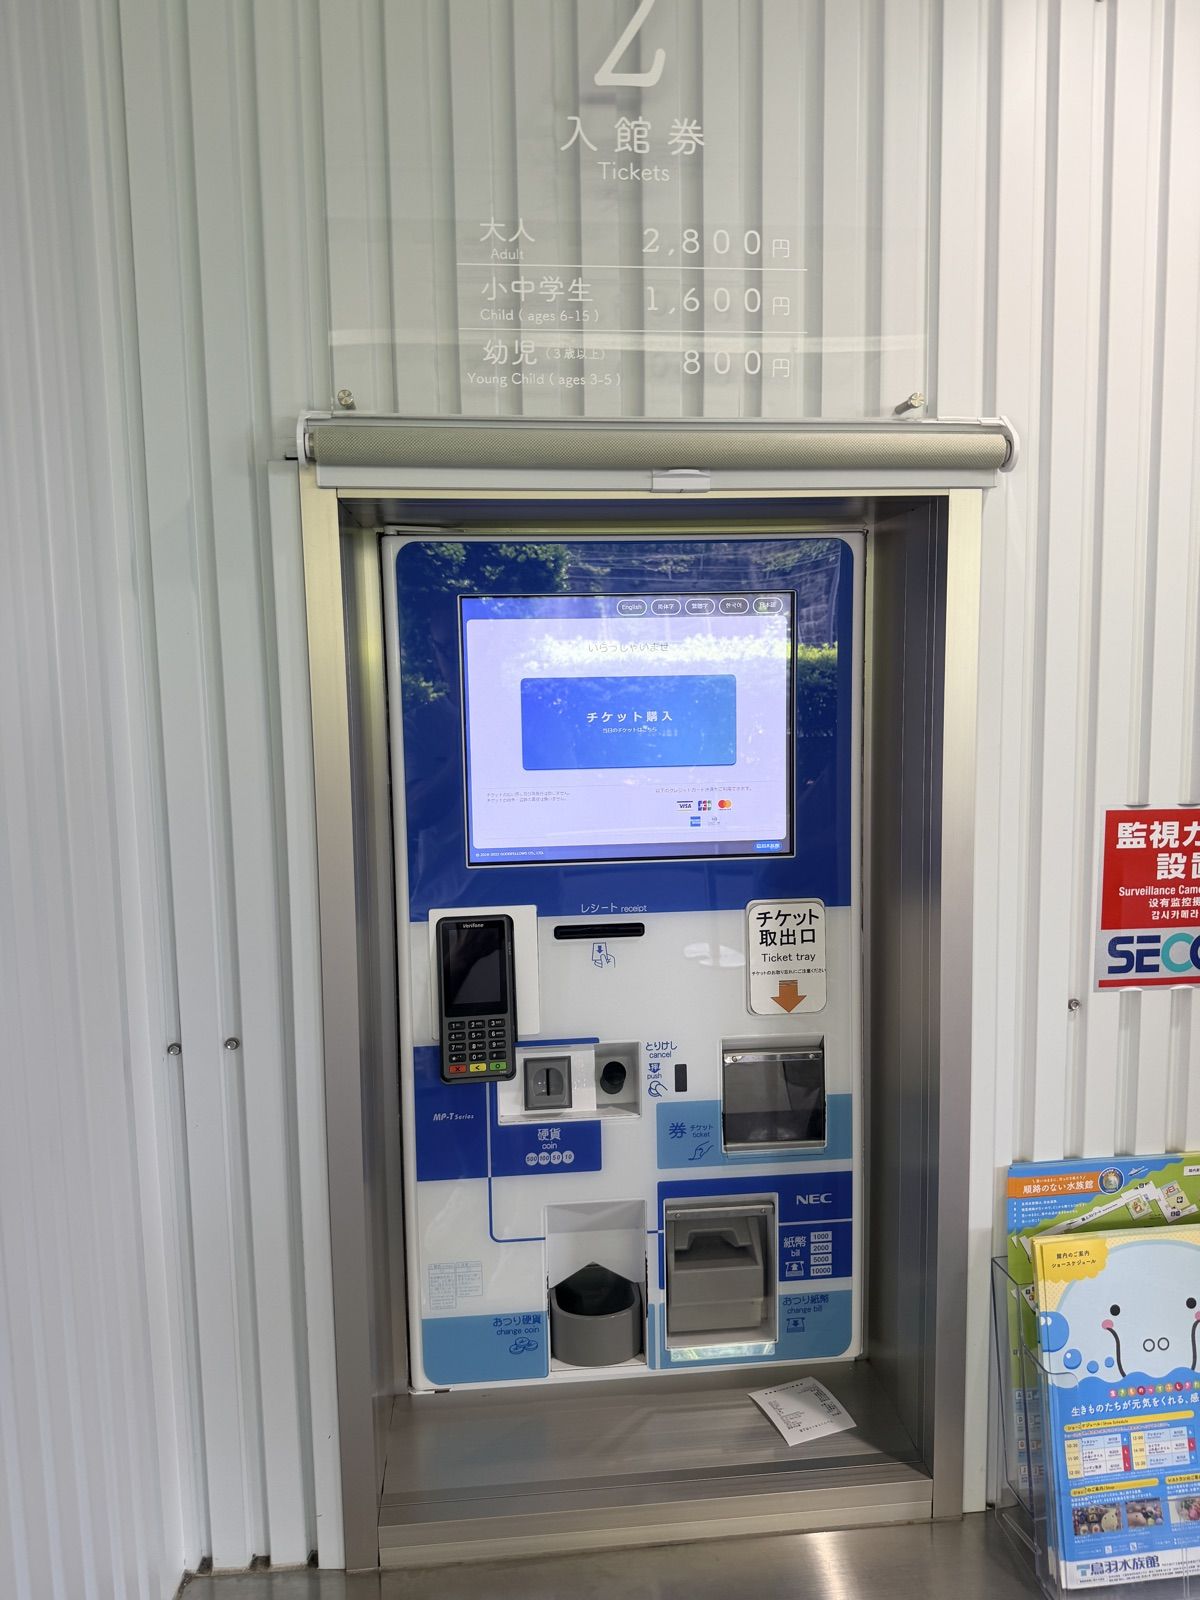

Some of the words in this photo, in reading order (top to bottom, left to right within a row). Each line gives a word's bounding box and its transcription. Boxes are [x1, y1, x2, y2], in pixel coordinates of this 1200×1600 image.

[560, 116, 705, 155] 入館券
[597, 161, 670, 182] Tickets
[479, 216, 535, 243] 大人
[490, 248, 524, 260] Adult
[481, 275, 594, 302] 小中学生
[480, 309, 514, 321] Child
[482, 339, 537, 365] 幼児
[467, 373, 508, 388] Young
[511, 373, 545, 385] Child
[588, 642, 669, 653] いらっしゃいませ
[586, 710, 672, 723] チケット購入
[1157, 852, 1200, 880] 設
[1118, 885, 1176, 896] Surveillance
[581, 902, 618, 913] レシート
[621, 905, 647, 913] receipt
[756, 908, 819, 927] チケット
[1151, 910, 1199, 920] 감시카메라
[759, 928, 816, 947] 取出口
[761, 953, 793, 963] Ticket
[796, 953, 816, 962] tray
[1108, 933, 1200, 974] SEC
[645, 1040, 678, 1052] とりけし
[649, 1051, 672, 1059] cancel
[433, 1113, 454, 1121] MP-T
[537, 1128, 561, 1141] 硬貨
[669, 1122, 687, 1139] 券
[542, 1142, 558, 1150] coin
[1022, 1180, 1094, 1194] 順路のない水族館
[796, 1193, 832, 1205] NEC
[783, 1236, 807, 1248] 紙幣
[1056, 1250, 1090, 1259] 館内のご案内
[1051, 1259, 1097, 1268] ショースケジュール
[783, 1294, 829, 1306] おつり紙幣
[786, 1306, 811, 1314] change
[813, 1305, 823, 1313] bill
[493, 1315, 541, 1327] おつり硬貨
[496, 1328, 522, 1336] change
[1091, 1555, 1161, 1576] 鳥羽水族館
